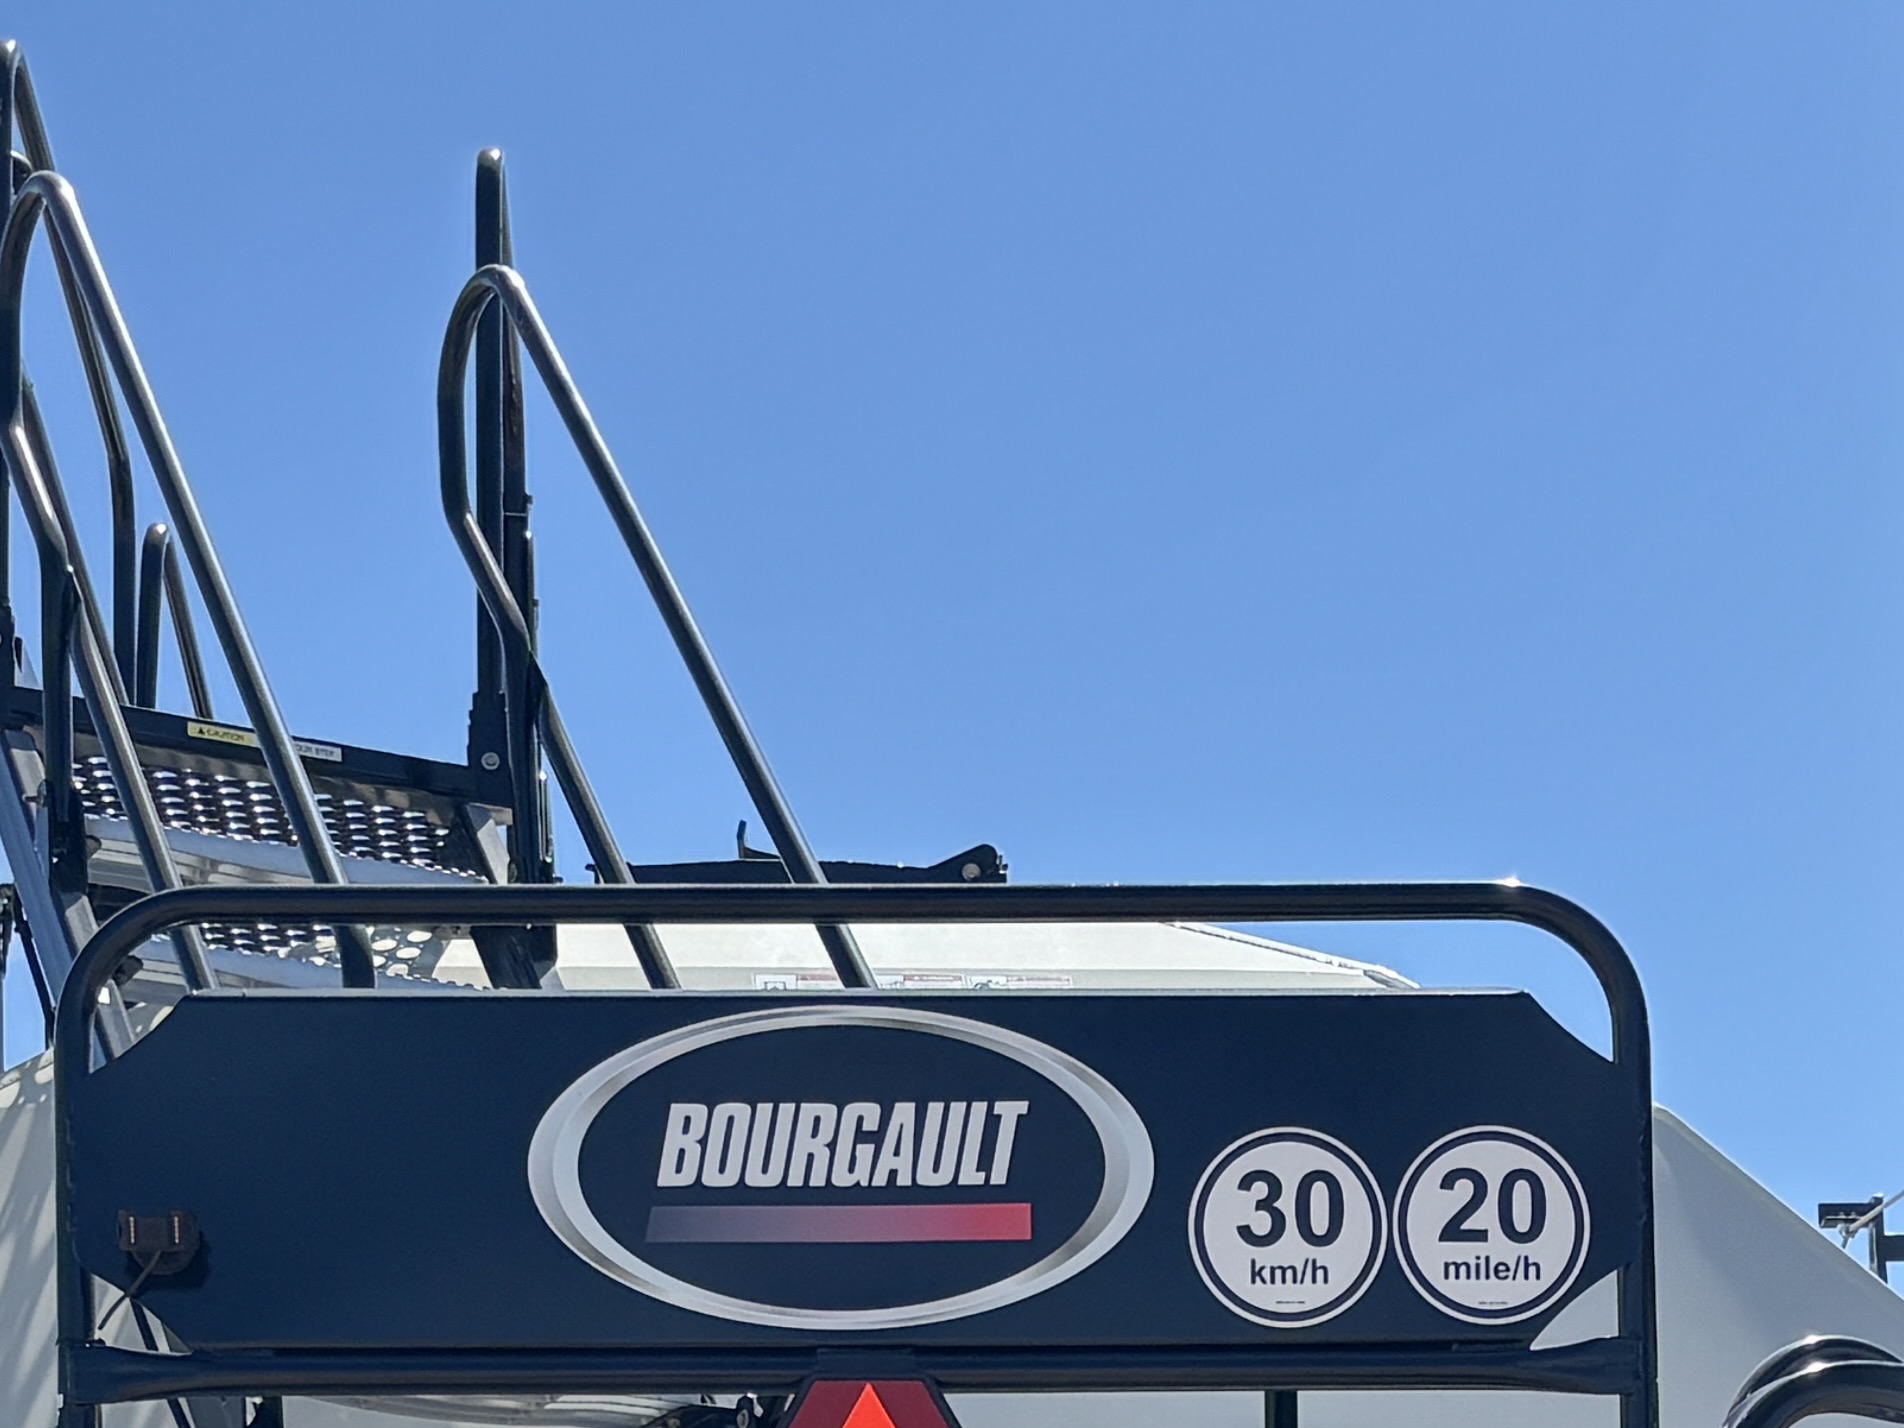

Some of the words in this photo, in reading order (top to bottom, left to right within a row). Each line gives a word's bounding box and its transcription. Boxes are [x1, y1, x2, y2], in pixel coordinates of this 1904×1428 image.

[657, 1101, 1029, 1188] BOURGAULT
[1236, 1169, 1344, 1248] 30
[1438, 1167, 1547, 1245] 20
[1249, 1258, 1330, 1285] km/h
[1443, 1255, 1542, 1282] mile/h
